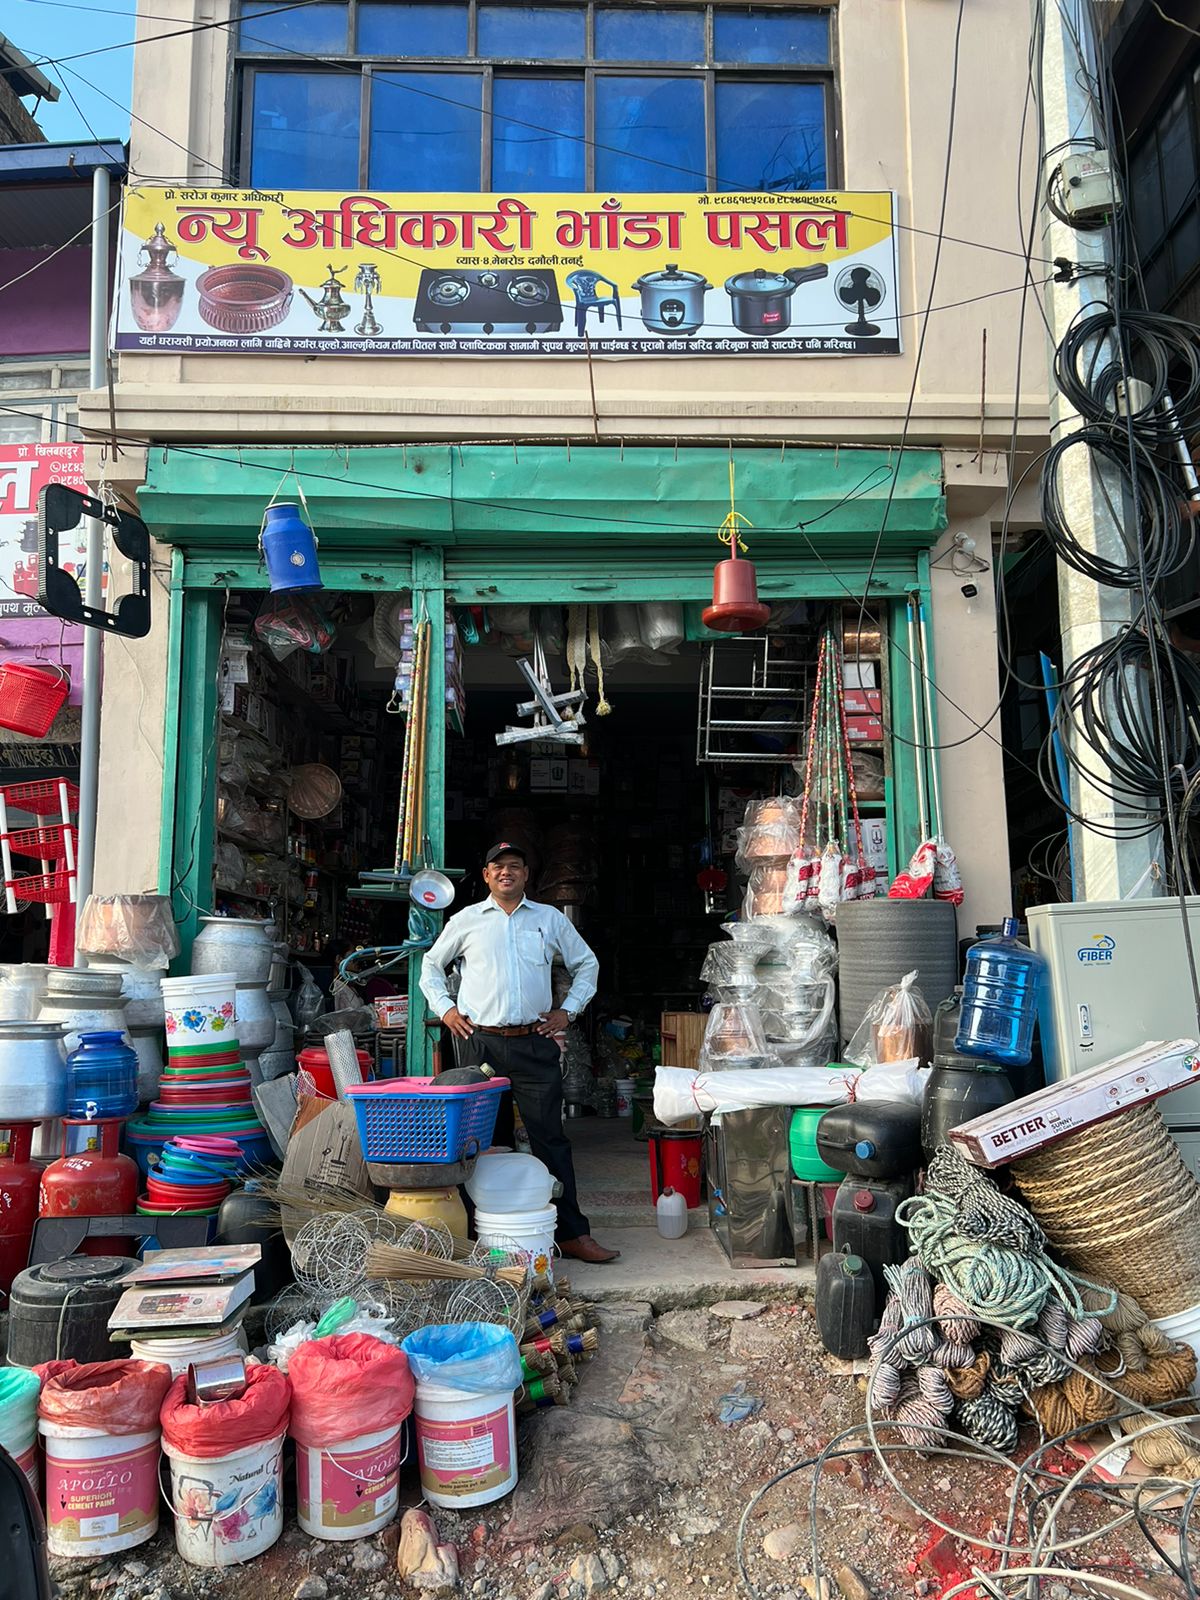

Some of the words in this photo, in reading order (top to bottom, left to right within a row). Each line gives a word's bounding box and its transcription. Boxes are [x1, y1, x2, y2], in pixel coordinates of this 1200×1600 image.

[180, 189, 208, 201] सरोज
[211, 191, 239, 203] कुमार
[242, 192, 284, 203] अधिकारी
[176, 206, 270, 262] न्यू
[282, 196, 537, 252] अधिकारी
[555, 197, 685, 251] भाँडा
[703, 211, 852, 253] पसल
[159, 336, 193, 347] घरायसी
[195, 336, 238, 348] प्रयोजनका
[240, 337, 263, 348] लागि
[265, 337, 291, 349] चाहिने
[632, 341, 639, 350] र
[641, 339, 665, 352] पुरानो
[689, 339, 713, 351] खरिद
[805, 339, 822, 350] पनि
[35, 444, 80, 459] खिलबहादुर
[1080, 950, 1113, 962] FIBER
[1051, 1116, 1073, 1130] SUNNY
[991, 1116, 1047, 1148] BETTER
[57, 1471, 132, 1491] APOLLO
[229, 1464, 264, 1486] Natural
[68, 1501, 94, 1511] CEMENT
[95, 1498, 116, 1509] PAINT
[70, 1491, 113, 1503] SUPERIOR
